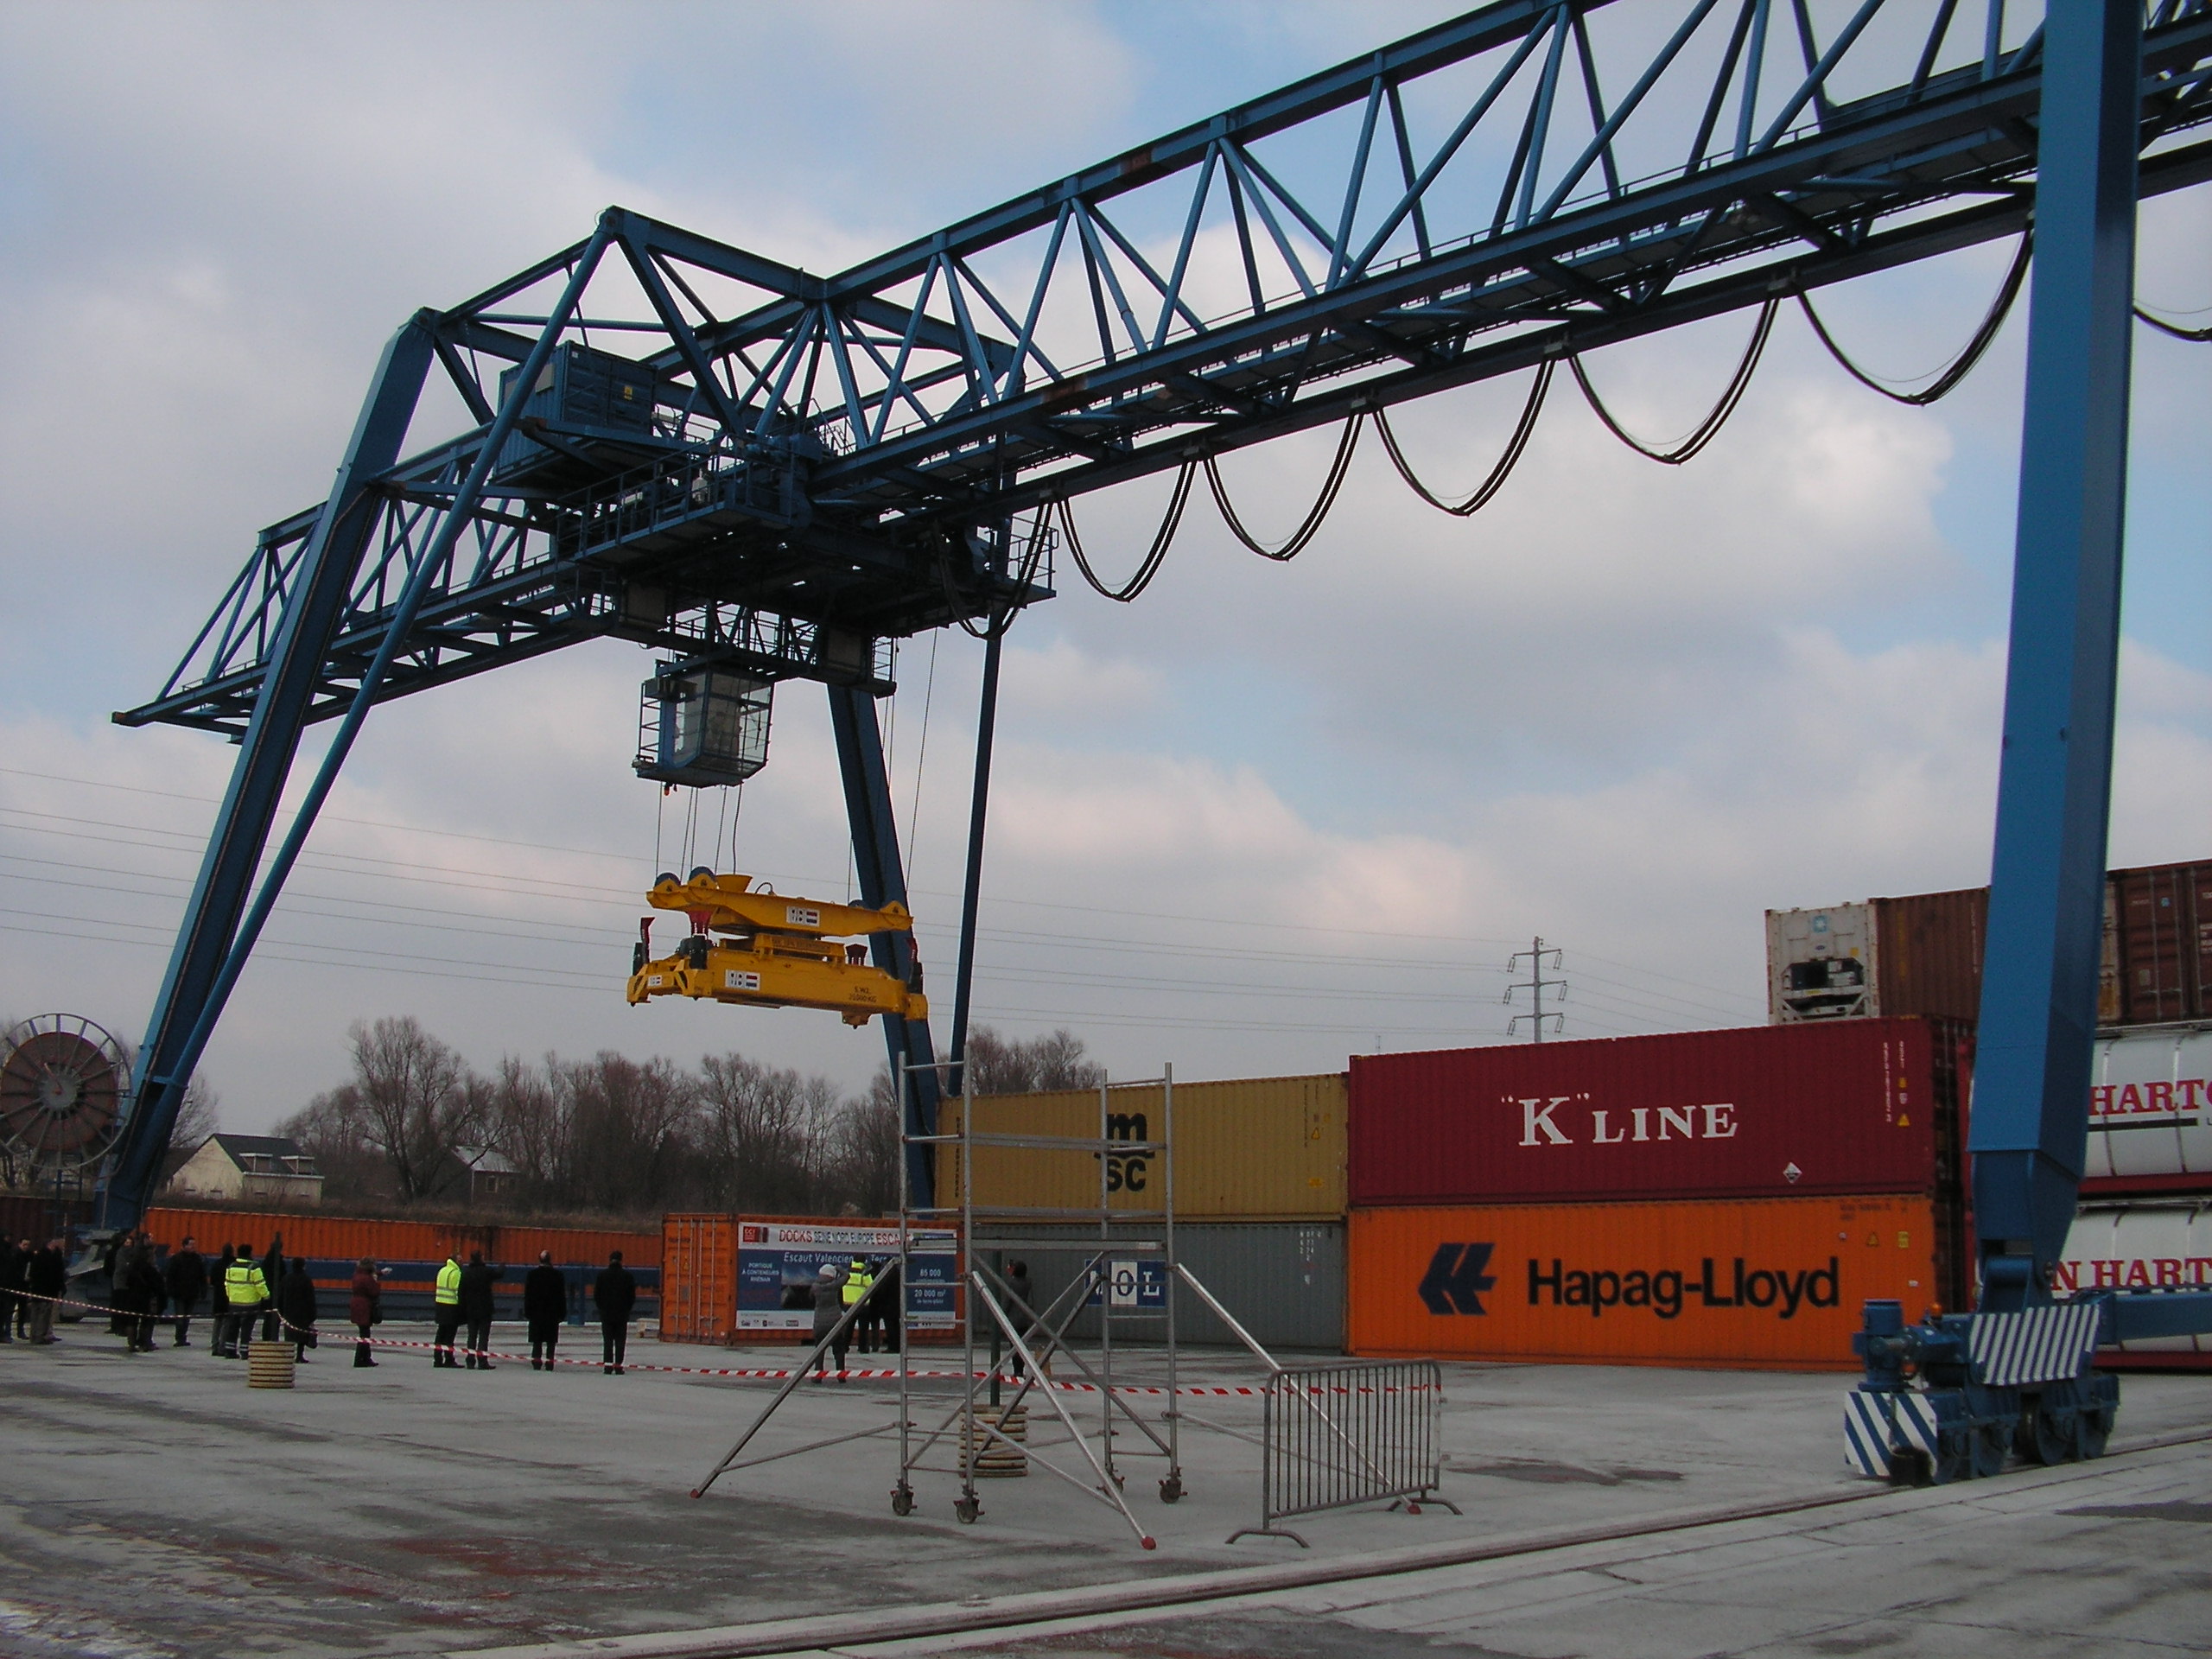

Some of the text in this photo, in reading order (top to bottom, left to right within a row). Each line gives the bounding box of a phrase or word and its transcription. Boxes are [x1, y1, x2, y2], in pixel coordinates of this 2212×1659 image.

[2088, 1078, 2212, 1116] HART
[1592, 1103, 1738, 1144] LINE
[779, 1230, 812, 1243] DOCKS
[875, 1233, 912, 1245] ESCA
[783, 1251, 814, 1262] Escaut
[924, 1288, 937, 1298] 000
[1528, 1255, 1840, 1319] Hapag-Lloyd
